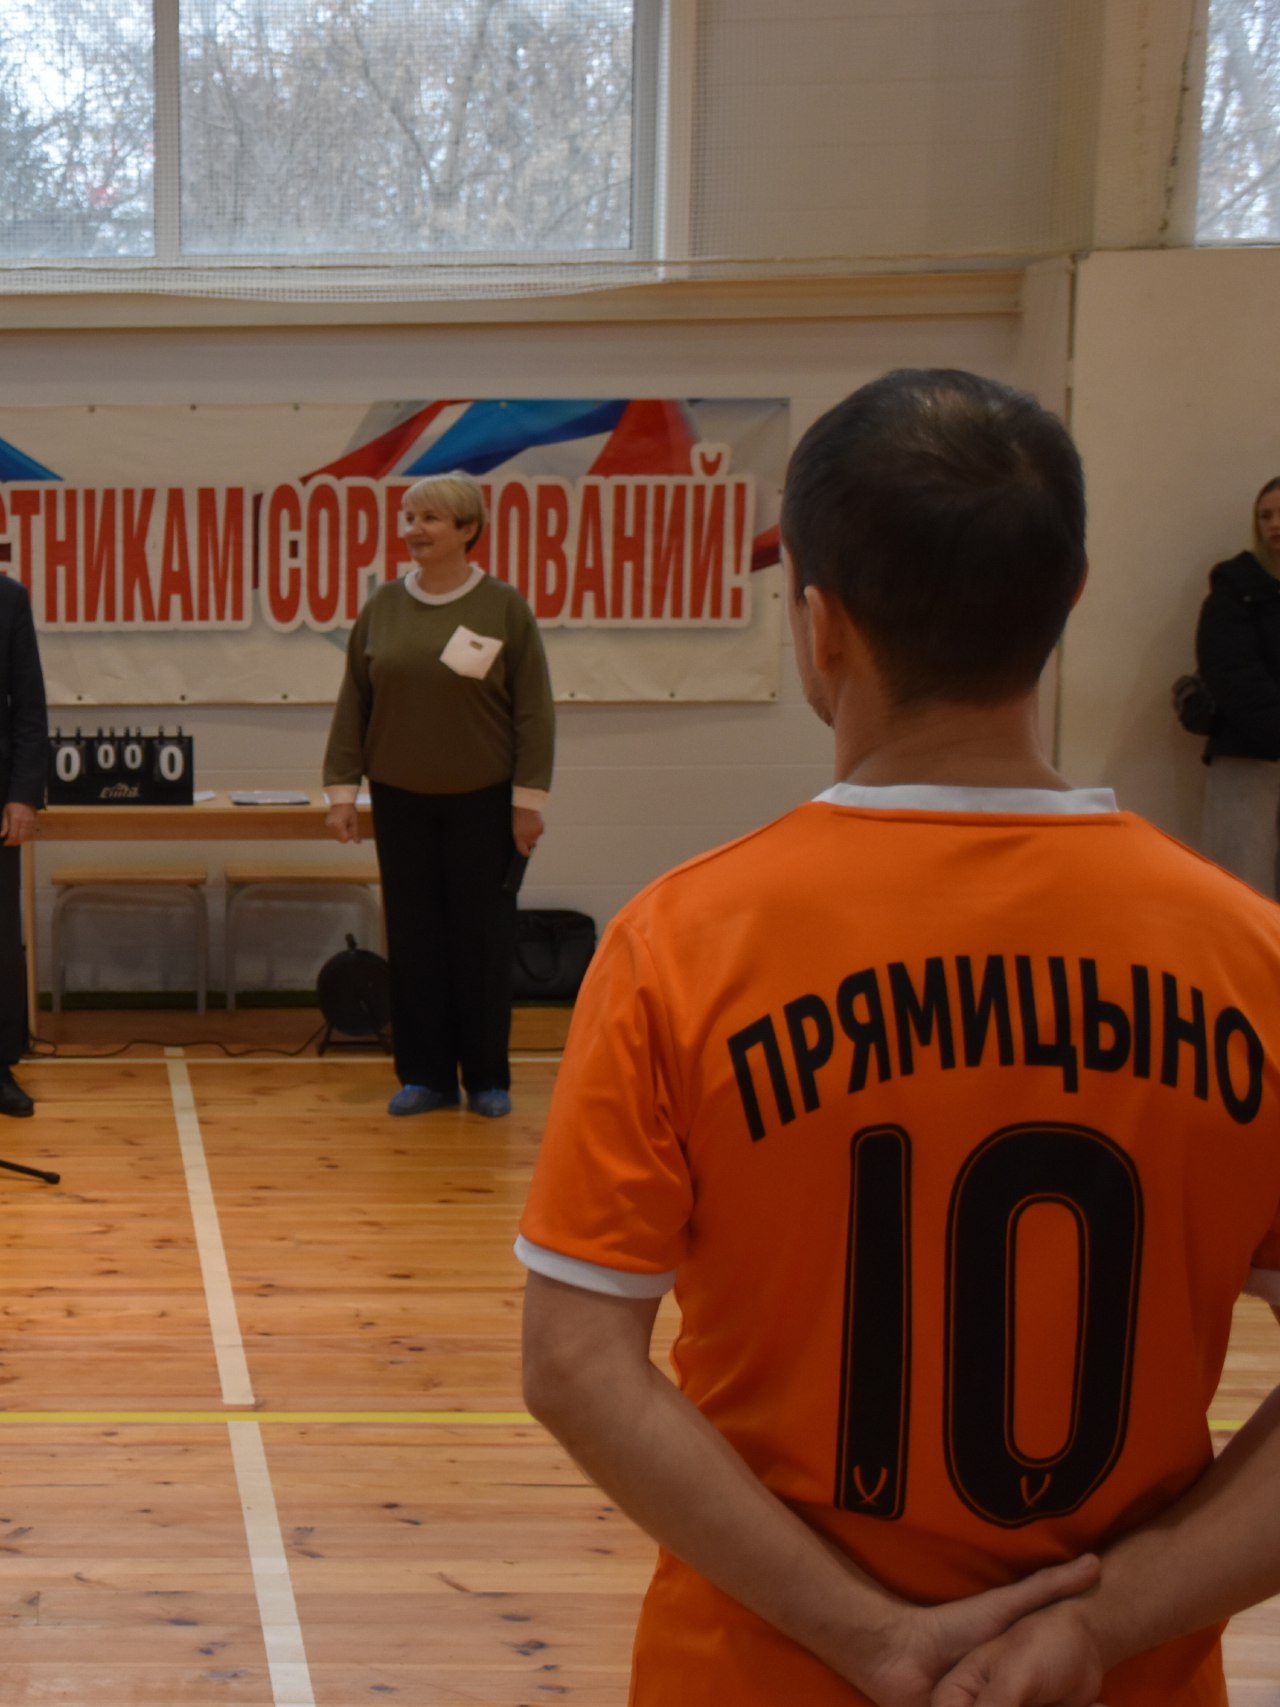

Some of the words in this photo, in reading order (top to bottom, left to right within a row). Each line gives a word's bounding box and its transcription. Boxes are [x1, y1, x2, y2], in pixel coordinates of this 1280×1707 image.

[267, 450, 747, 624] СОРЕОВАНИЙ!
[56, 746, 81, 782] 0
[159, 745, 184, 781] 0
[726, 954, 1265, 1143] ПРЯМИЦЫНО
[833, 1121, 1145, 1530] 10
